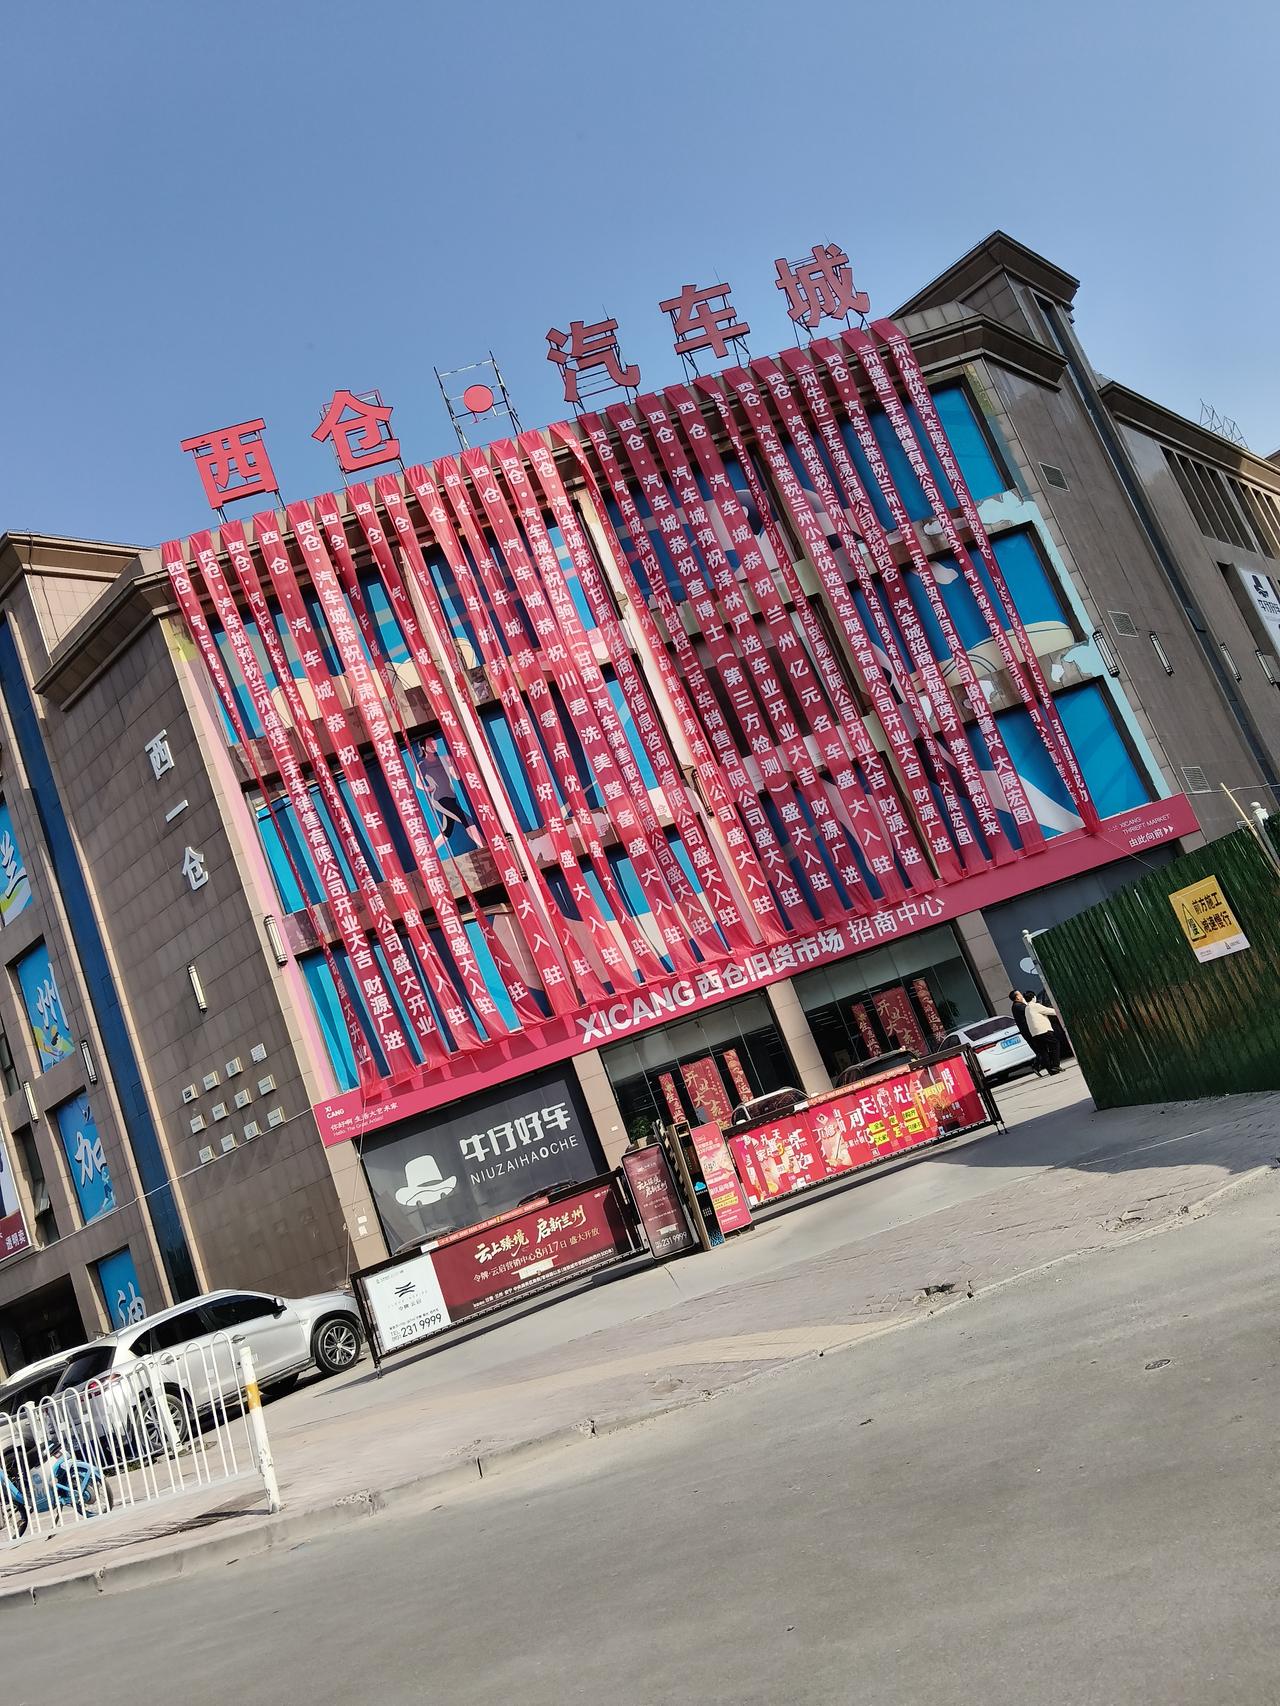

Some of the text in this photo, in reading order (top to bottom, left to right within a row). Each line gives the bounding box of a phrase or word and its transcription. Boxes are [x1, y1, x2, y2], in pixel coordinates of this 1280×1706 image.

[678, 400, 894, 875] 西仓·汽车城恭祝兰州亿元名车盛大入驻
[911, 785, 952, 855] 财源广进
[939, 777, 973, 846] 大展宏图
[949, 737, 1000, 837] 携手共赢创未来
[992, 754, 1033, 826] 大展宏图
[810, 796, 862, 886] 财源广进
[878, 795, 922, 867] 财源广进
[1129, 829, 1163, 847] 由此向前
[1192, 891, 1222, 915] 前方施工
[1200, 911, 1232, 933] 减速慢行
[576, 895, 945, 1044] XICANG 西仓旧货市场 招商中心
[362, 974, 406, 1052] 财源广进
[459, 1102, 571, 1162] 牛仔好车
[470, 1135, 579, 1185] NIUZAIHAOCHE
[401, 1323, 418, 1337] 231
[419, 1313, 442, 1329] 9999
